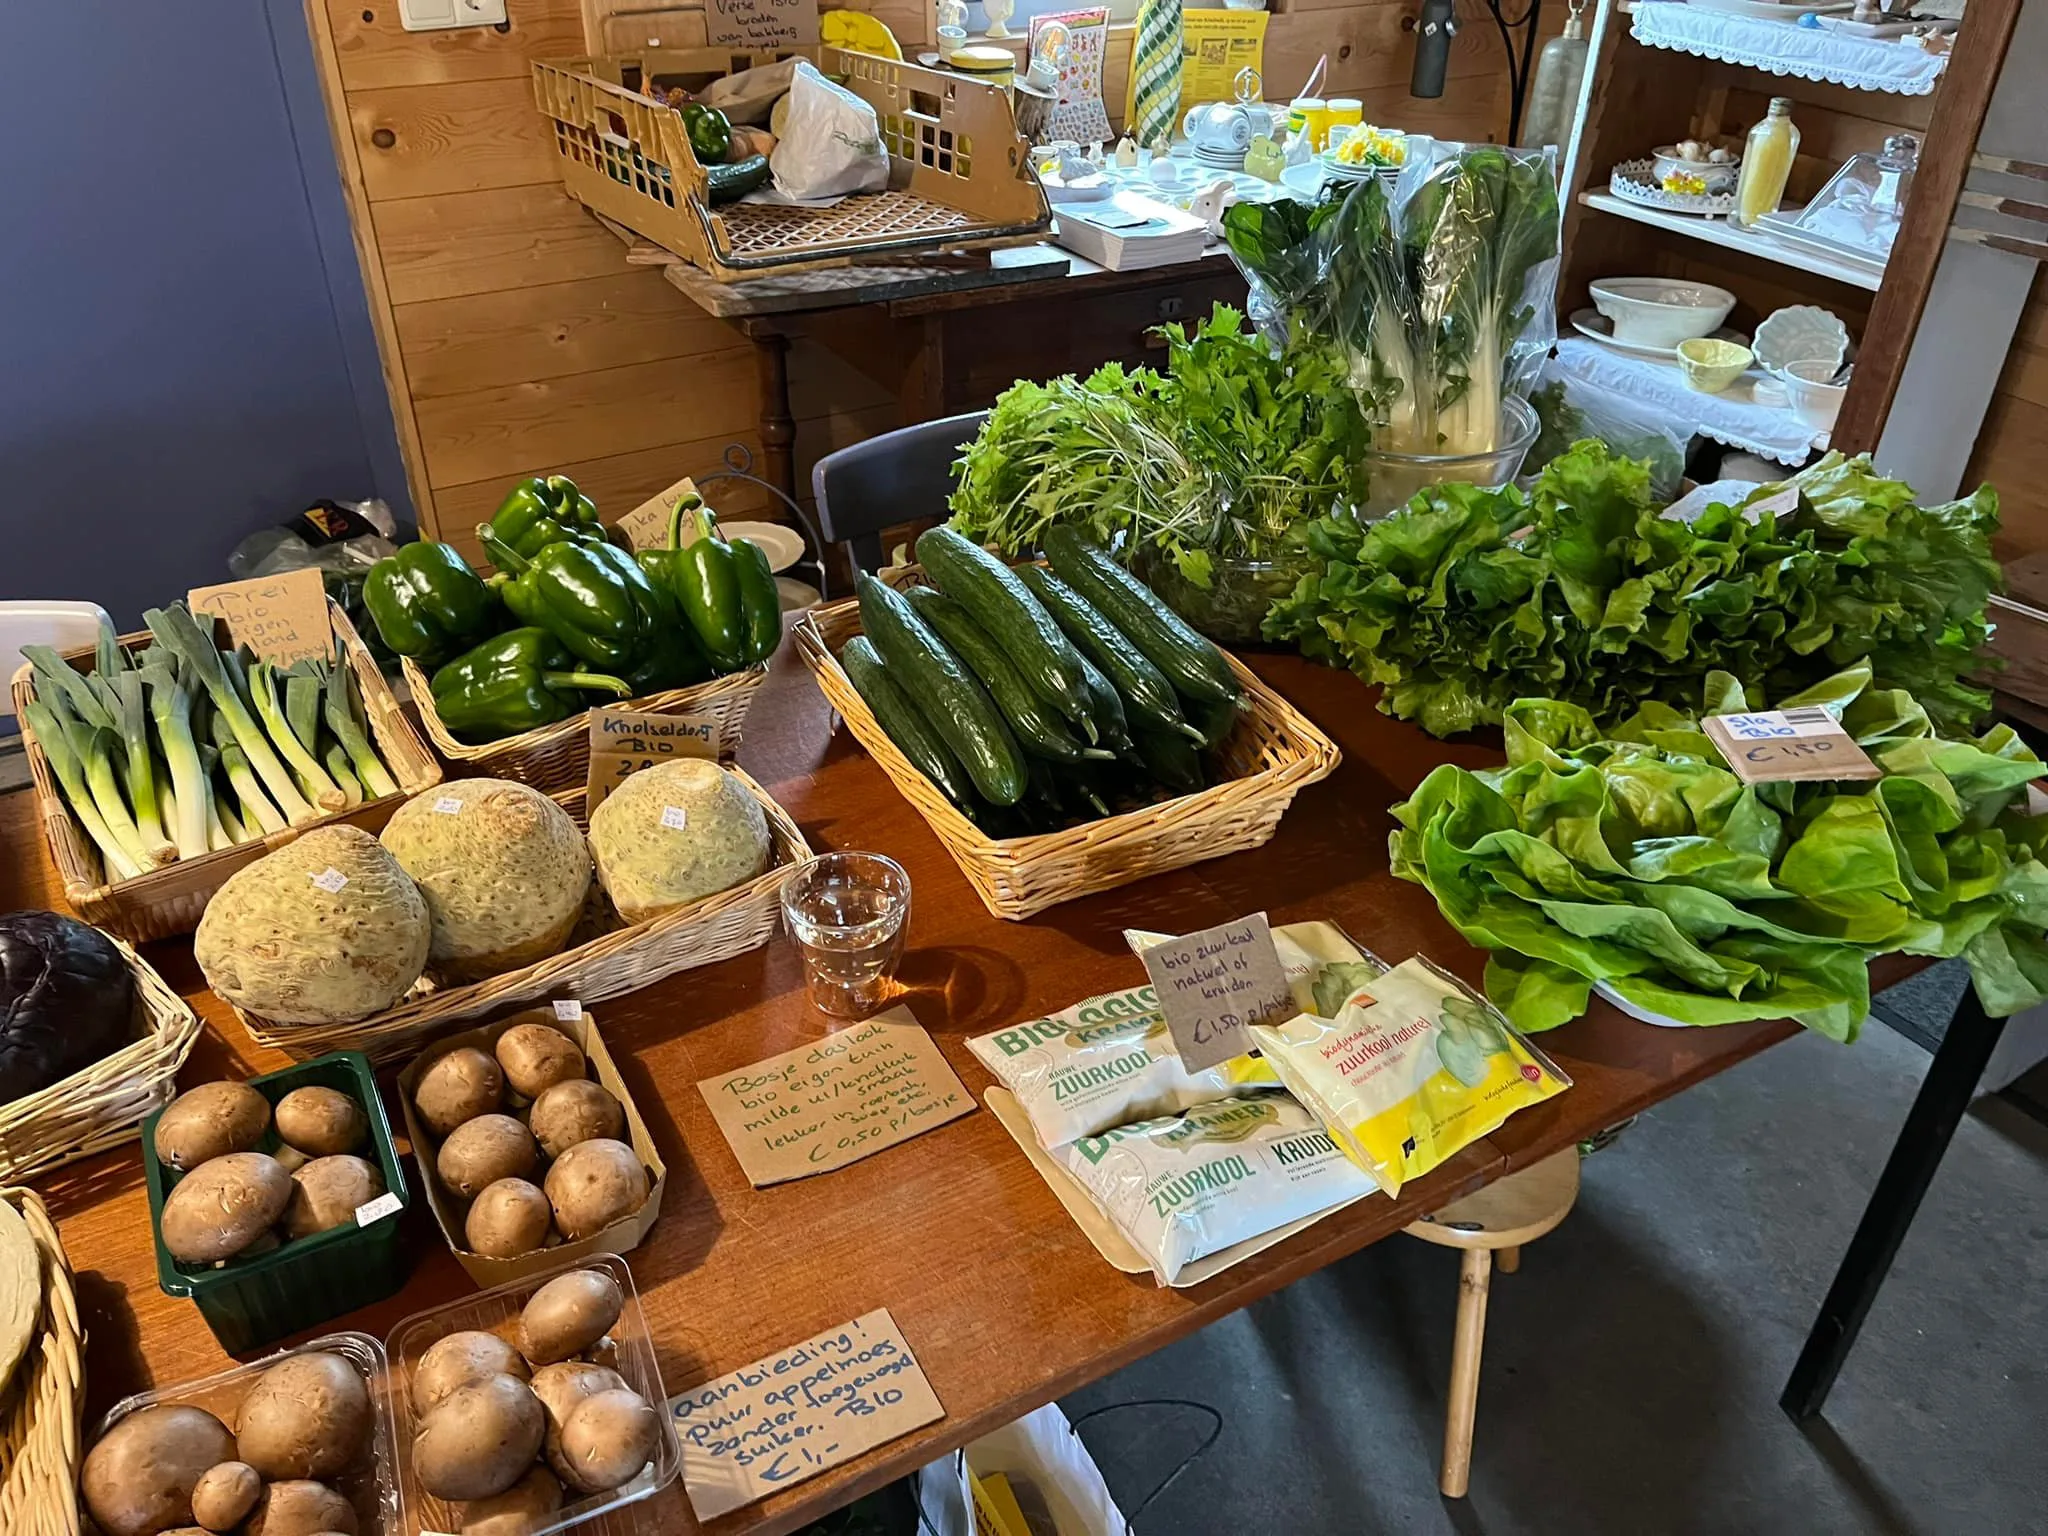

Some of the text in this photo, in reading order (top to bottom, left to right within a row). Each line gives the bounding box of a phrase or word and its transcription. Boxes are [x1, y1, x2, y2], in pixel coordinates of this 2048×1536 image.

[202, 580, 288, 609] Prei
[226, 607, 269, 624] bio
[231, 618, 291, 638] eigen
[250, 630, 299, 649] land
[1727, 714, 1775, 728] Sla
[616, 737, 674, 752] BIO
[1160, 951, 1191, 969] bio
[1234, 952, 1249, 970] of
[1201, 976, 1254, 1000] kruiden
[1335, 1032, 1392, 1077] zuurkool
[1390, 1015, 1433, 1046] naturel
[721, 1062, 798, 1096] Bosje
[740, 1042, 895, 1110] bio eigen tuin
[857, 1066, 918, 1097] smaak
[1048, 1050, 1157, 1102] ZUURKOOL
[743, 1103, 801, 1132] milde
[763, 1119, 827, 1151] lekker
[832, 1110, 854, 1122] in
[837, 1125, 883, 1150] 0,50
[1147, 1153, 1257, 1219] ZUURKOOL
[685, 1338, 898, 1448] puur appelmoes
[834, 1387, 904, 1418] BIO
[706, 1409, 799, 1457] zonder
